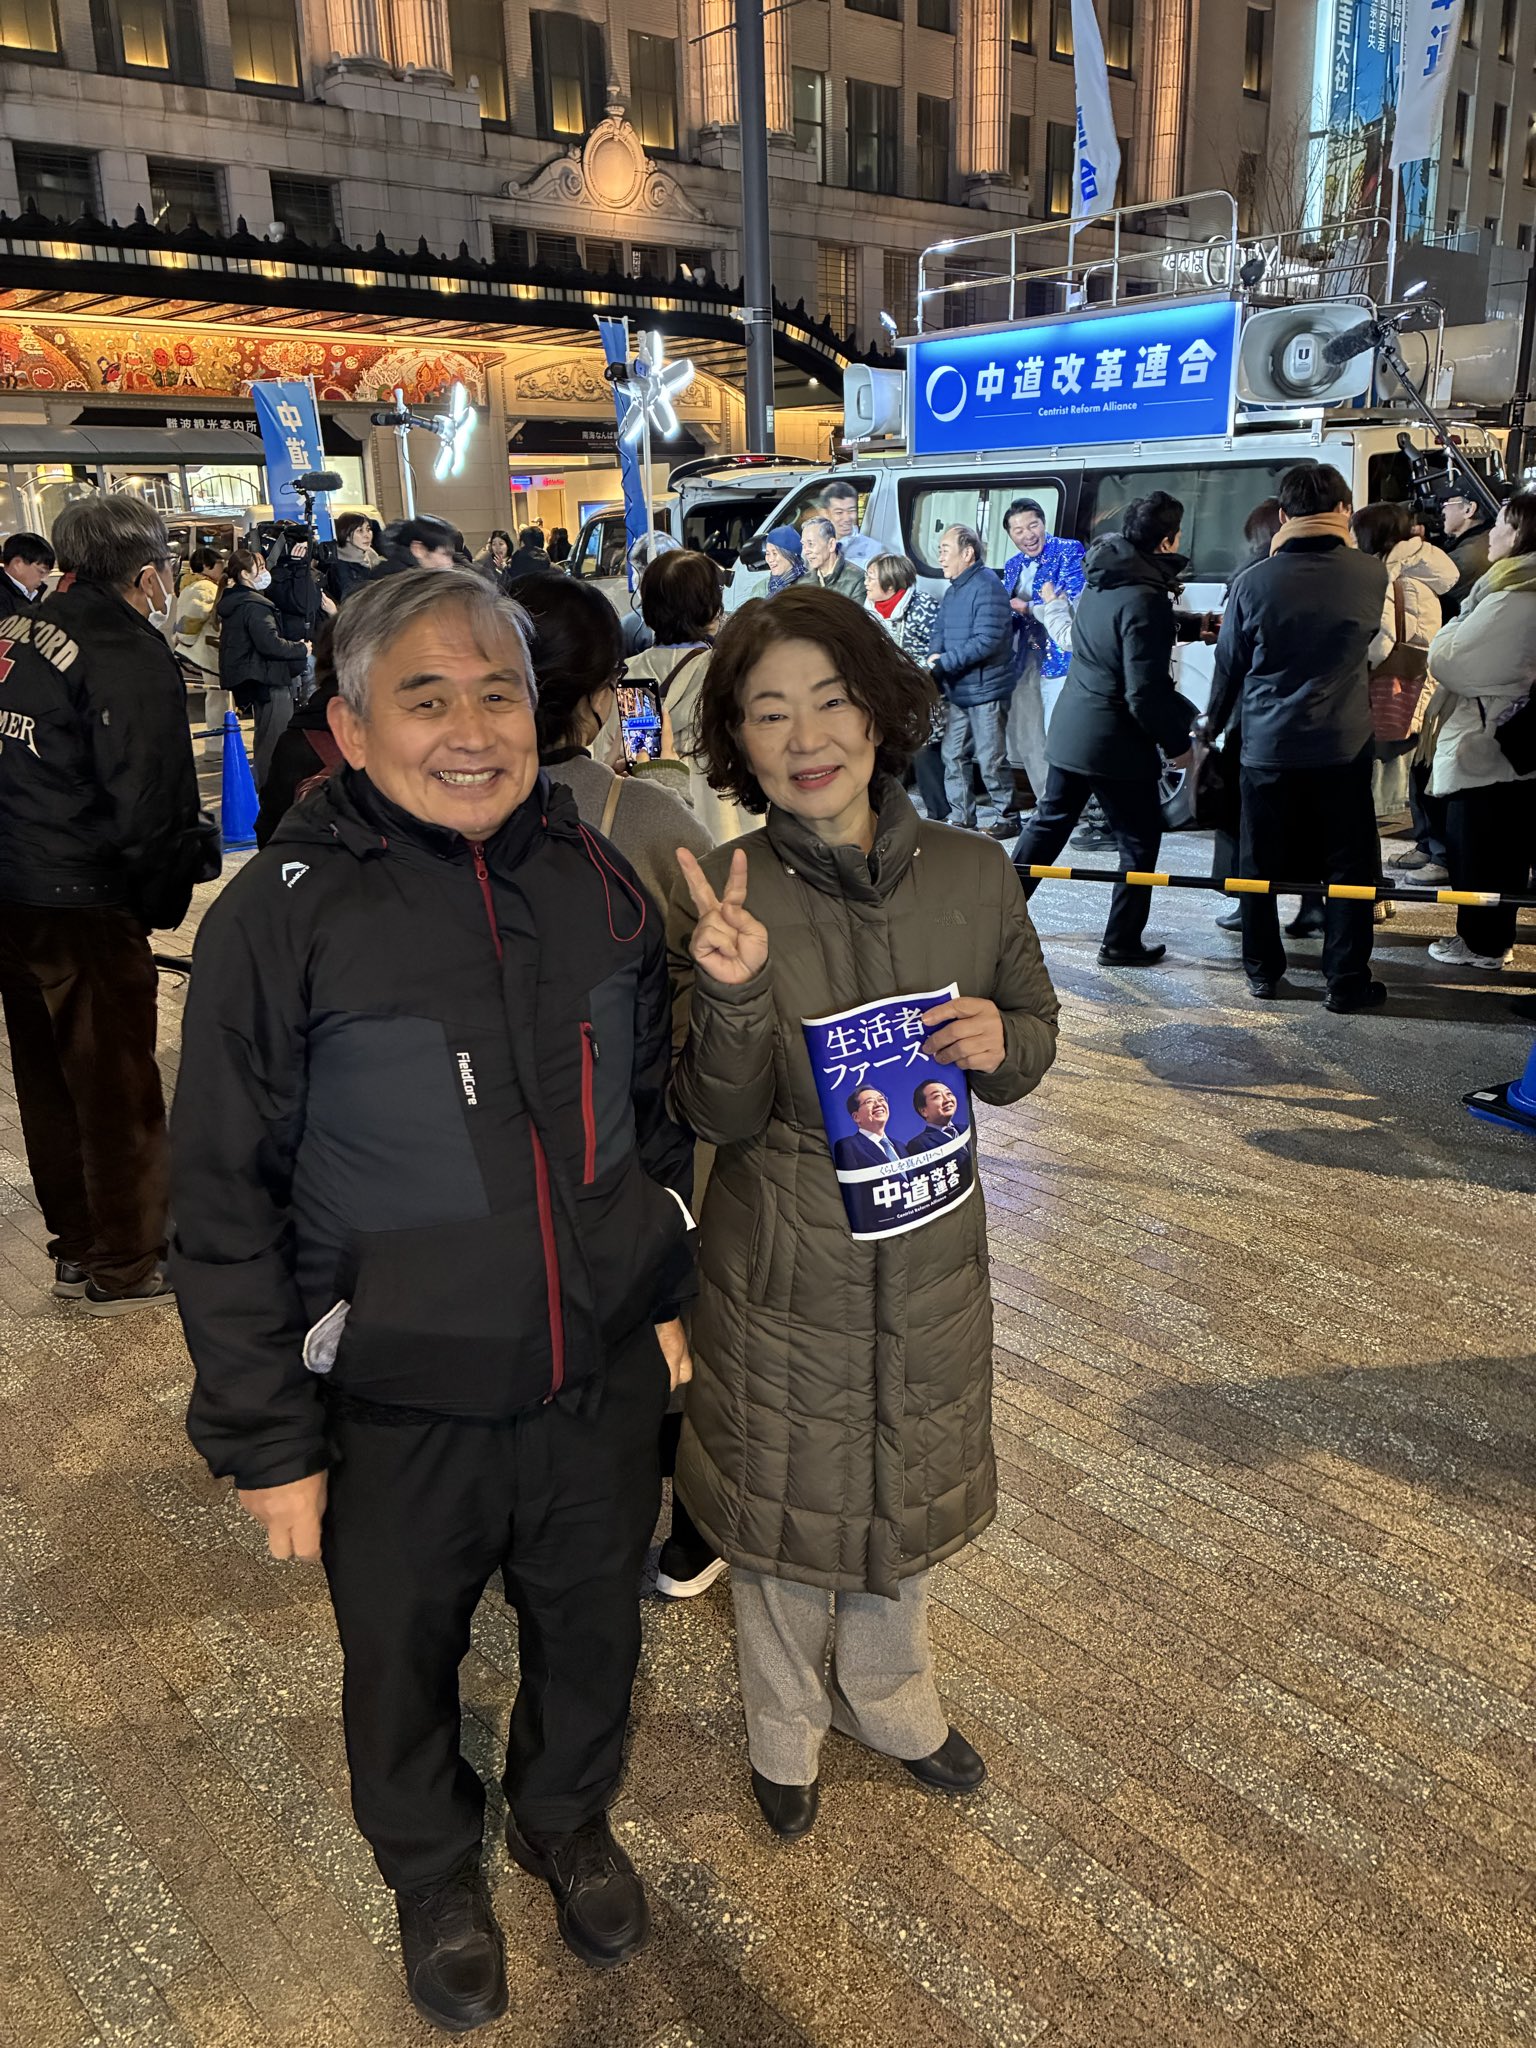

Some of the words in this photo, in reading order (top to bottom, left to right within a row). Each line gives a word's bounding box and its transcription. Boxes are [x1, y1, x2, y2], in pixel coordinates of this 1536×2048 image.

[975, 338, 1217, 402] 中道改革連合
[165, 417, 257, 433] 難波観光案内所
[1038, 405, 1069, 417] Centrist
[1070, 403, 1101, 414] Reform
[1103, 401, 1138, 412] Alliance
[826, 1007, 925, 1061] 生活者
[456, 1052, 477, 1106] FieldCore
[823, 1035, 931, 1091] ファース
[872, 1174, 932, 1210] 中道
